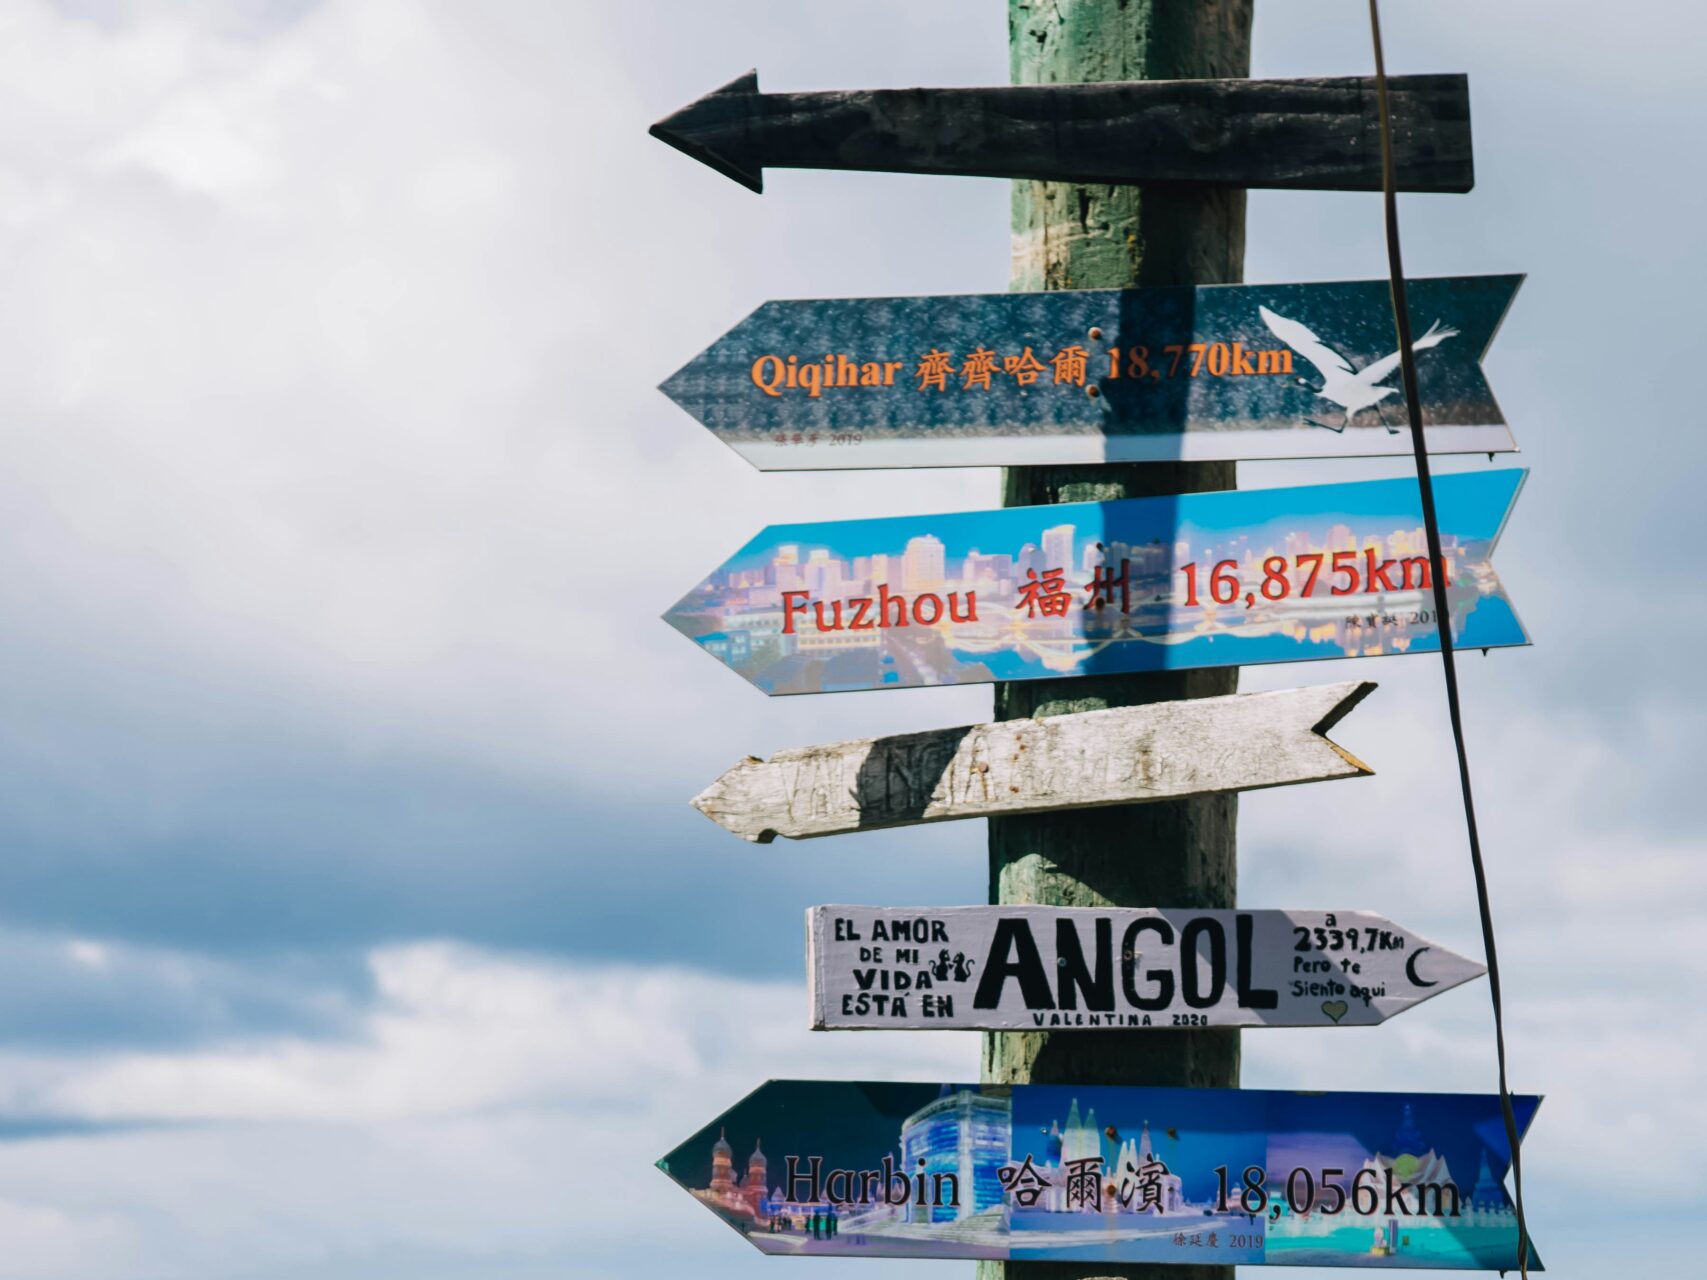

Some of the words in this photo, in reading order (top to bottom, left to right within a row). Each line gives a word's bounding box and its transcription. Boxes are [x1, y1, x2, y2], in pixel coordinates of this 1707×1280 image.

[752, 354, 903, 397] Qiqihar
[915, 345, 1090, 392] 齊齊哈爾
[1107, 342, 1293, 383] 18,770km
[781, 583, 979, 634] Fuzhou
[1015, 558, 1131, 619] 福州
[1181, 547, 1451, 609] 16,875km
[1409, 609, 1440, 625] 201
[1325, 913, 1337, 927] a
[834, 918, 861, 941] EL
[871, 918, 949, 943] AMOR
[859, 947, 883, 963] DE
[896, 948, 919, 964] MI
[973, 914, 1278, 1012] ANGOL
[1294, 956, 1331, 973] Pero
[1340, 958, 1361, 975] te
[852, 969, 932, 990] VIDA
[1291, 979, 1345, 997] Siento
[842, 992, 910, 1018] ESTÁ
[922, 995, 954, 1018] EN
[1032, 1013, 1152, 1027] VALENTINA
[1172, 1014, 1208, 1026] 2020
[785, 1155, 960, 1207] Harbin
[997, 1153, 1170, 1214] 哈爾濱
[1213, 1164, 1461, 1222] 18,056km
[1229, 1234, 1263, 1248] 2019
